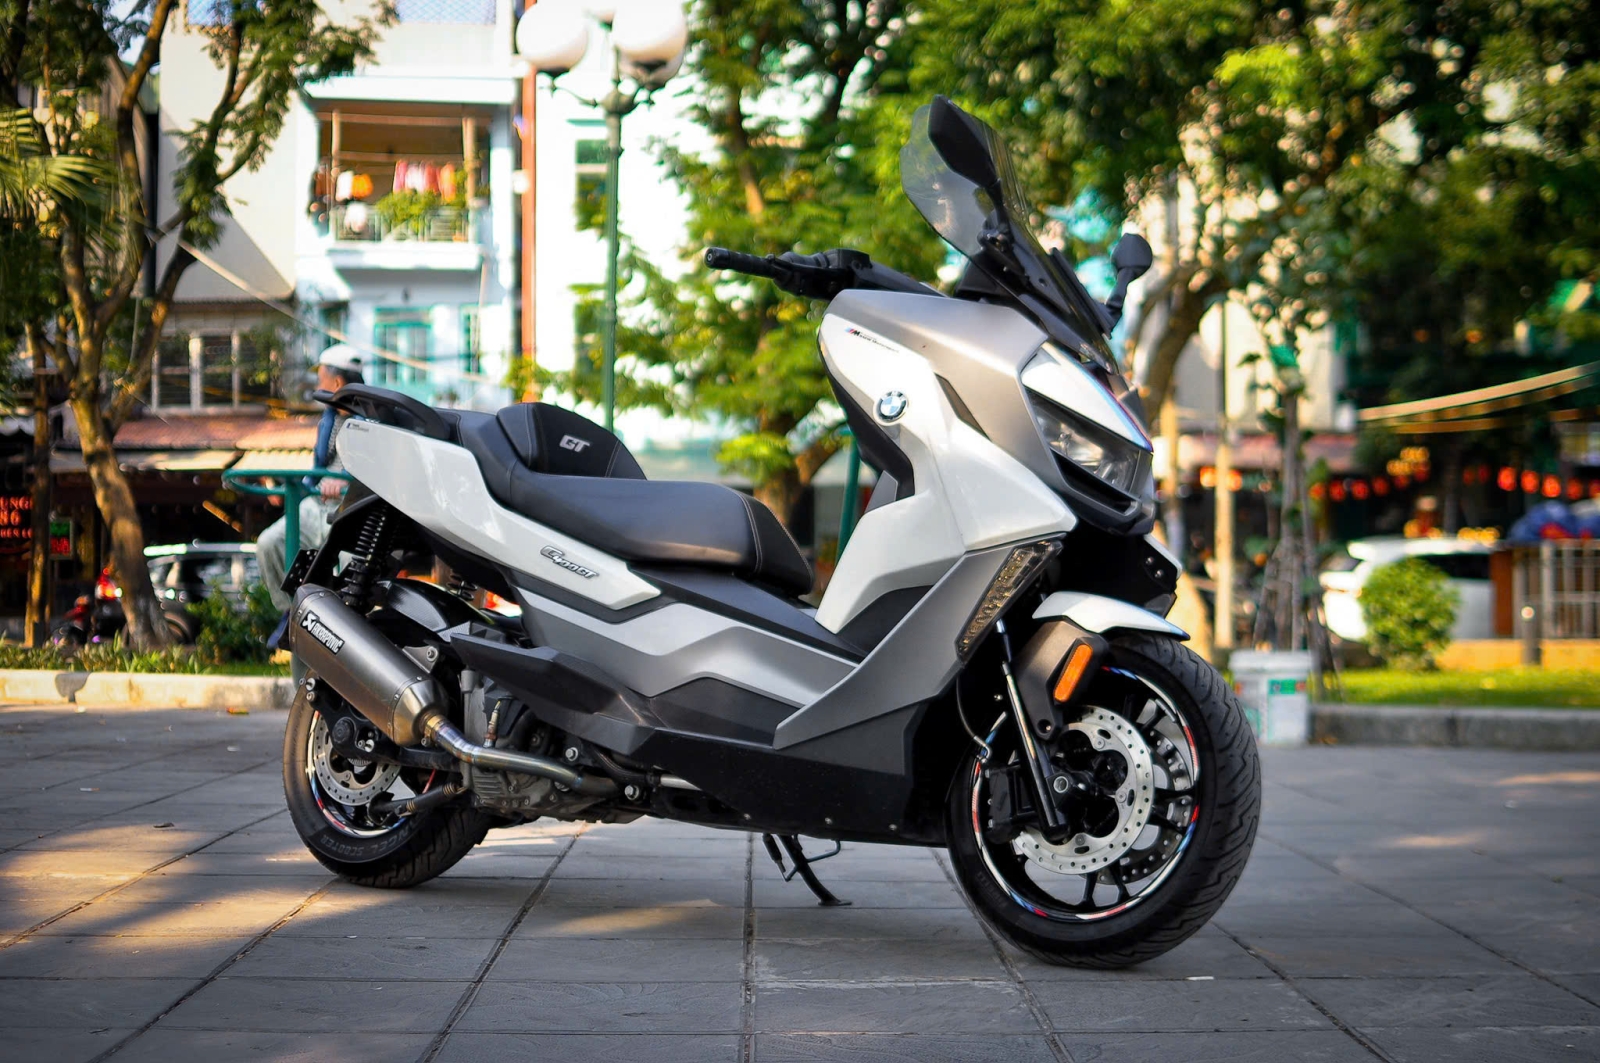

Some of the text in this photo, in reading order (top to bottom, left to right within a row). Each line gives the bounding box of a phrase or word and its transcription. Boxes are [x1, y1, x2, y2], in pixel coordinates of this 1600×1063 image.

[559, 434, 590, 452] GT
[540, 545, 600, 579] C400GT
[320, 834, 364, 857] SCOOTER
